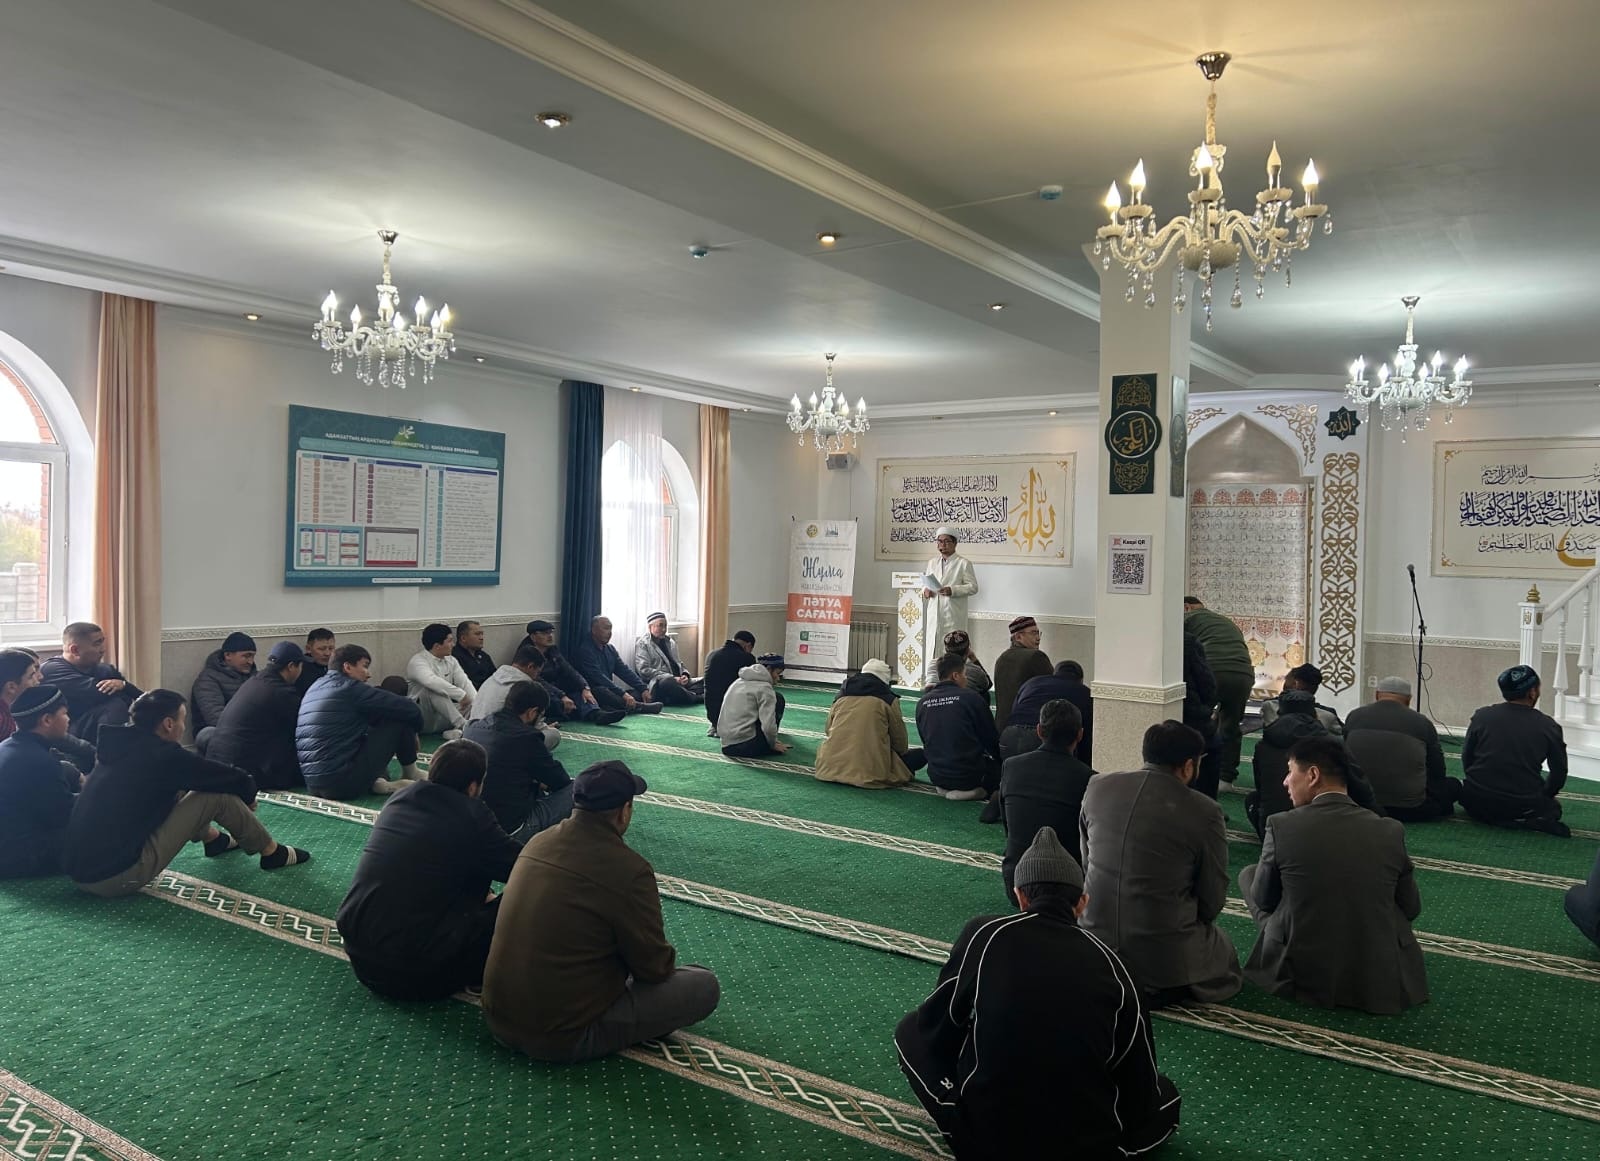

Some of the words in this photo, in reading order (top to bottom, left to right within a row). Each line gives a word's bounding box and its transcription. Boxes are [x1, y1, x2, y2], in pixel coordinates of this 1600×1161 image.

[802, 556, 844, 582] Жума
[803, 597, 841, 608] ПӘТУА
[796, 608, 844, 620] САҒАТЫ
